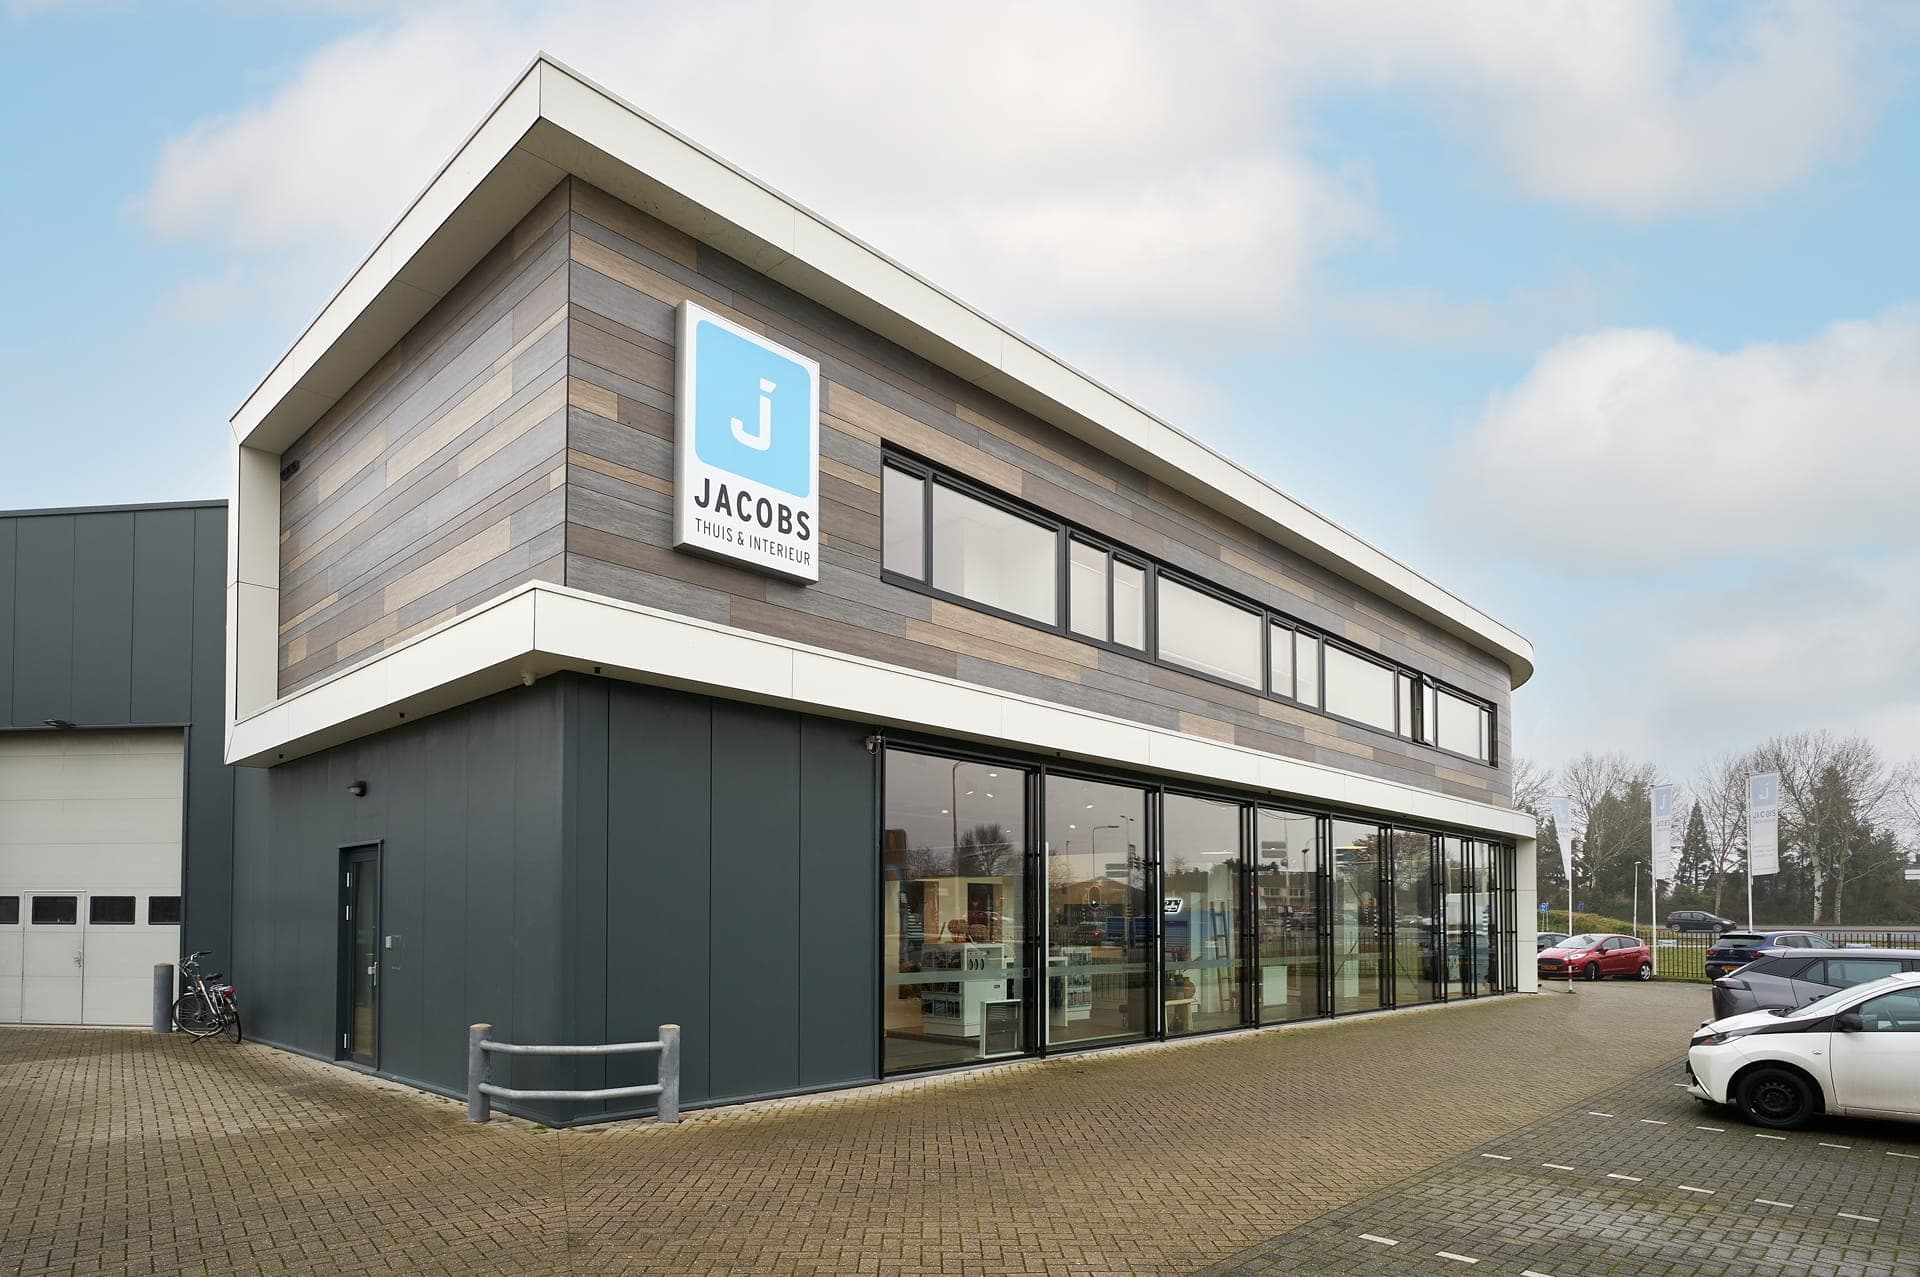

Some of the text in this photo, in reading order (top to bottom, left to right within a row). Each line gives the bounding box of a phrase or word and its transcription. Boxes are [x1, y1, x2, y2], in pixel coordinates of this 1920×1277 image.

[694, 478, 810, 541] JACOBS
[695, 517, 811, 567] THUIS & INTERIEUR
